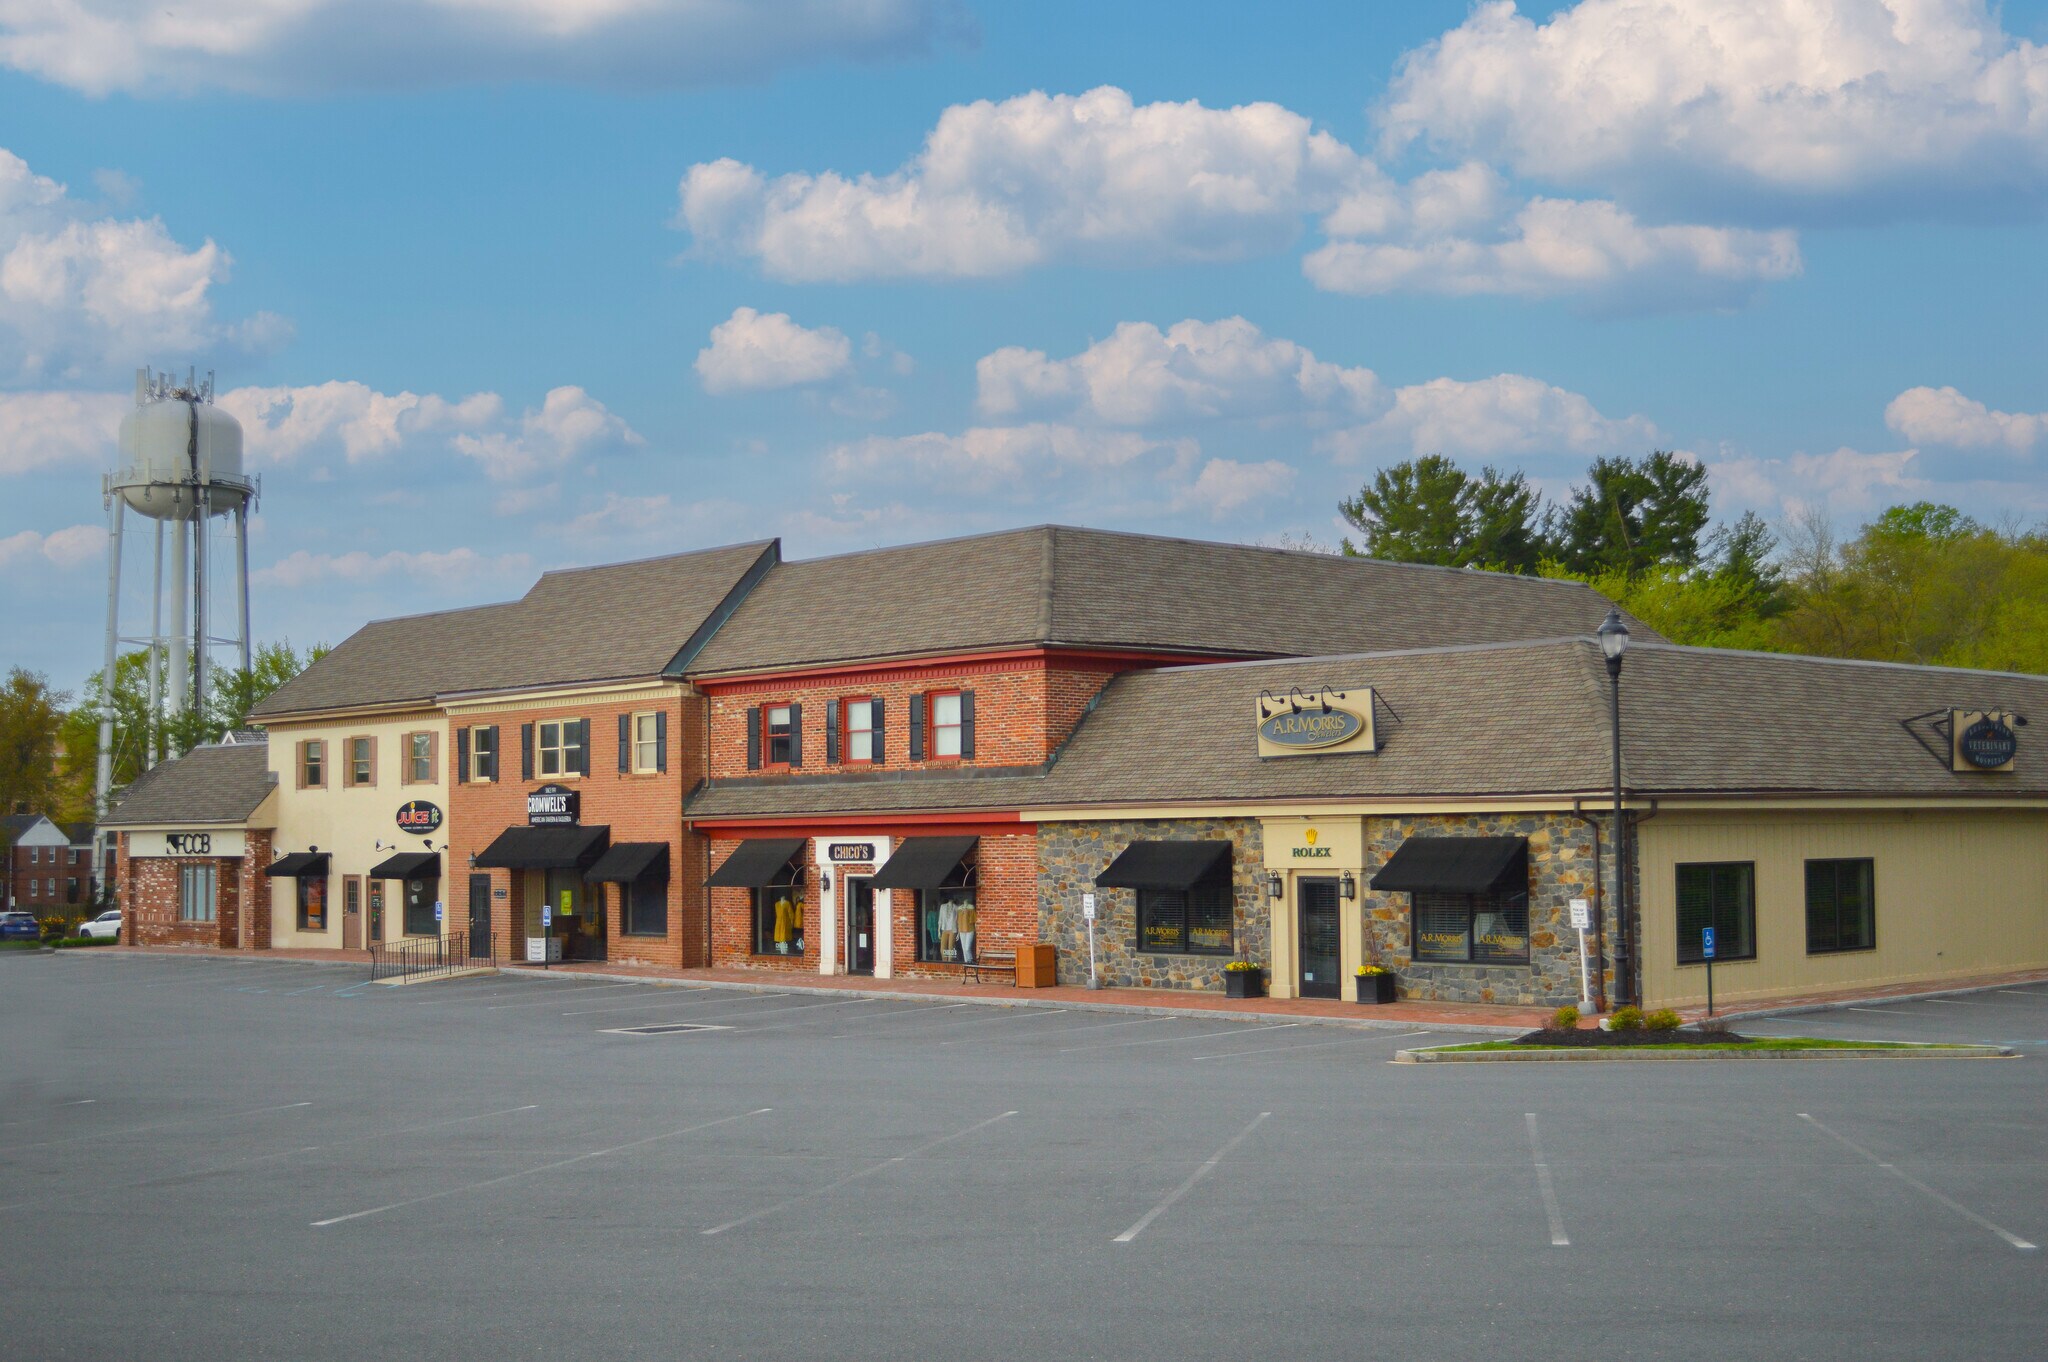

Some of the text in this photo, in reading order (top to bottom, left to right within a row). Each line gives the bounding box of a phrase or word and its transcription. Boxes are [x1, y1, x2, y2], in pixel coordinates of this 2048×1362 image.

[1968, 740, 2011, 750] VETERINARY
[1975, 755, 2005, 766] HOSPITAL
[528, 796, 567, 813] CROMWELL'S
[834, 845, 869, 859] CHICO'S
[1292, 847, 1332, 857] ROLEX
